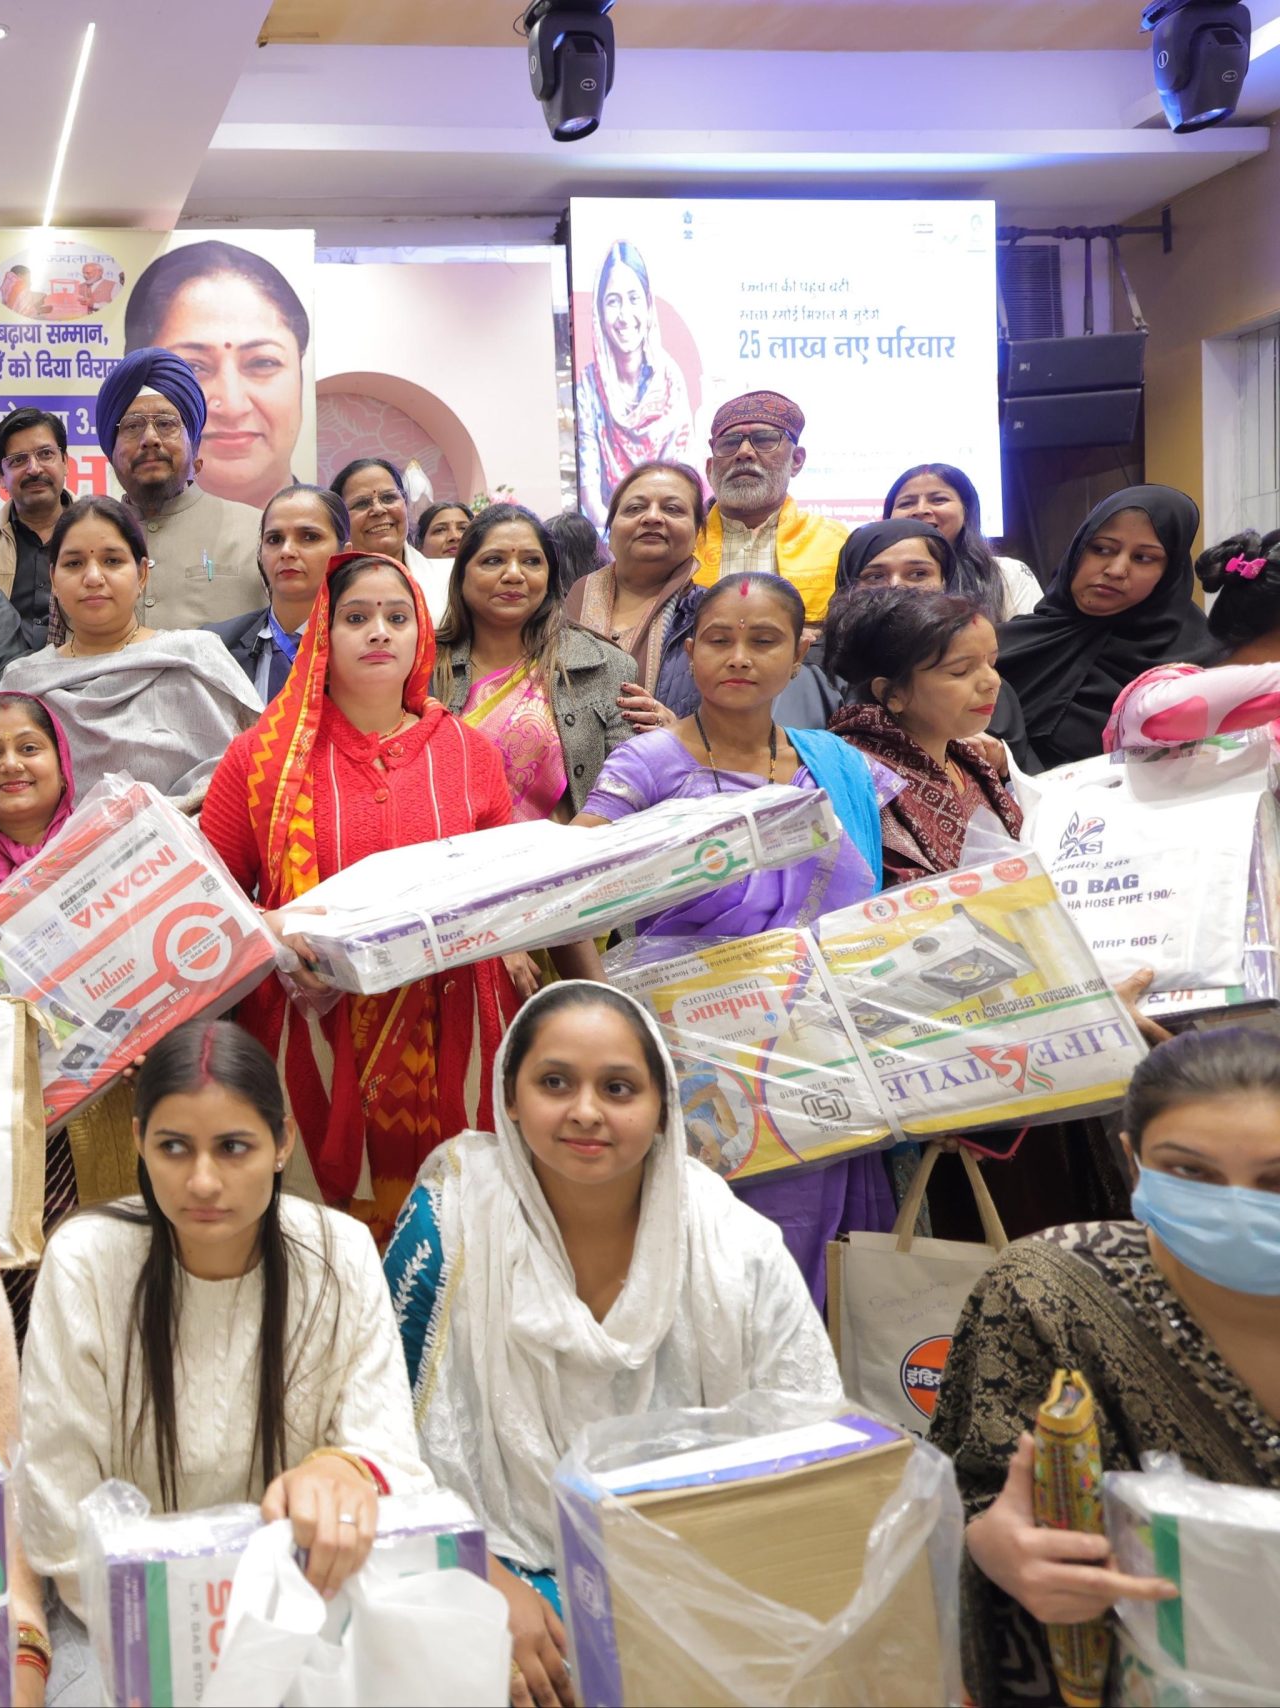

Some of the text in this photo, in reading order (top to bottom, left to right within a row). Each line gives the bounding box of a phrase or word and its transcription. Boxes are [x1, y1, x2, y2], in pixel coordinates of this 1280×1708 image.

[47, 324, 109, 345] सम्मान,
[739, 325, 956, 364] 25 लाख नए परिवार
[8, 351, 31, 378] को
[36, 350, 72, 378] दिया
[1104, 858, 1131, 869] gas
[69, 845, 178, 929] INDANA
[1087, 874, 1139, 894] BAG
[64, 898, 89, 918] GREEN
[1085, 897, 1116, 908] HOSE
[1118, 893, 1143, 905] PIPE
[1147, 888, 1177, 901] 190/-
[876, 905, 886, 916] 3
[1092, 939, 1126, 949] MRP
[1130, 935, 1158, 947] 605
[83, 957, 136, 1000] Indane
[639, 975, 664, 989] Ensure
[671, 969, 688, 979] Hose
[681, 979, 762, 1010] Distributors
[1034, 982, 1081, 1006] THERMAL
[1081, 976, 1106, 994] HIGH
[169, 987, 190, 1005] EEco
[684, 989, 770, 1024] Indane
[980, 994, 1034, 1019] EFFICIENCY
[872, 1052, 905, 1068] ECO
[190, 1622, 201, 1654] GAS
